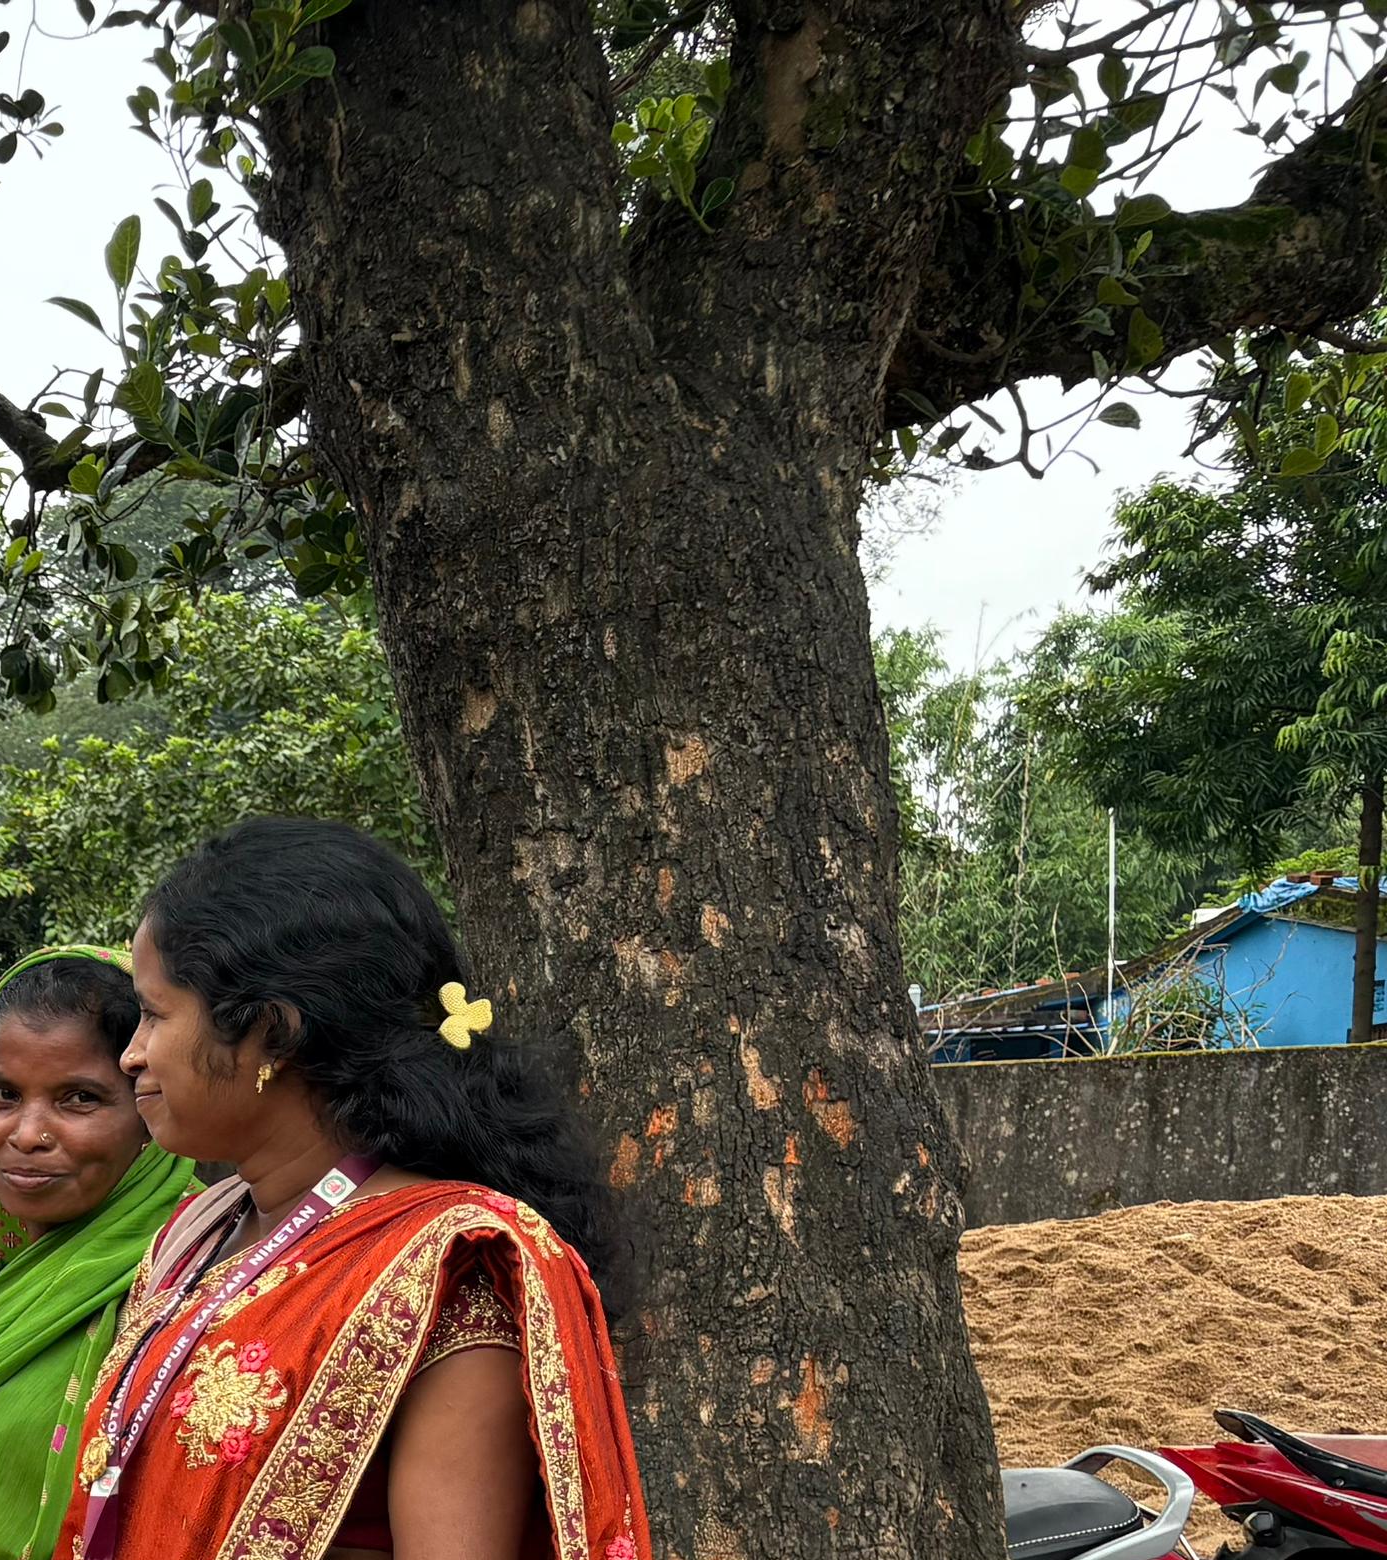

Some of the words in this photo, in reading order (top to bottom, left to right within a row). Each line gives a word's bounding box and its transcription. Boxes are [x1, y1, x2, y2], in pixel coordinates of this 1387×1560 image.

[121, 1335, 190, 1458] CHOTANAGPUR
[190, 1270, 247, 1330] KALYAN
[248, 1204, 316, 1267] NIKETAN
